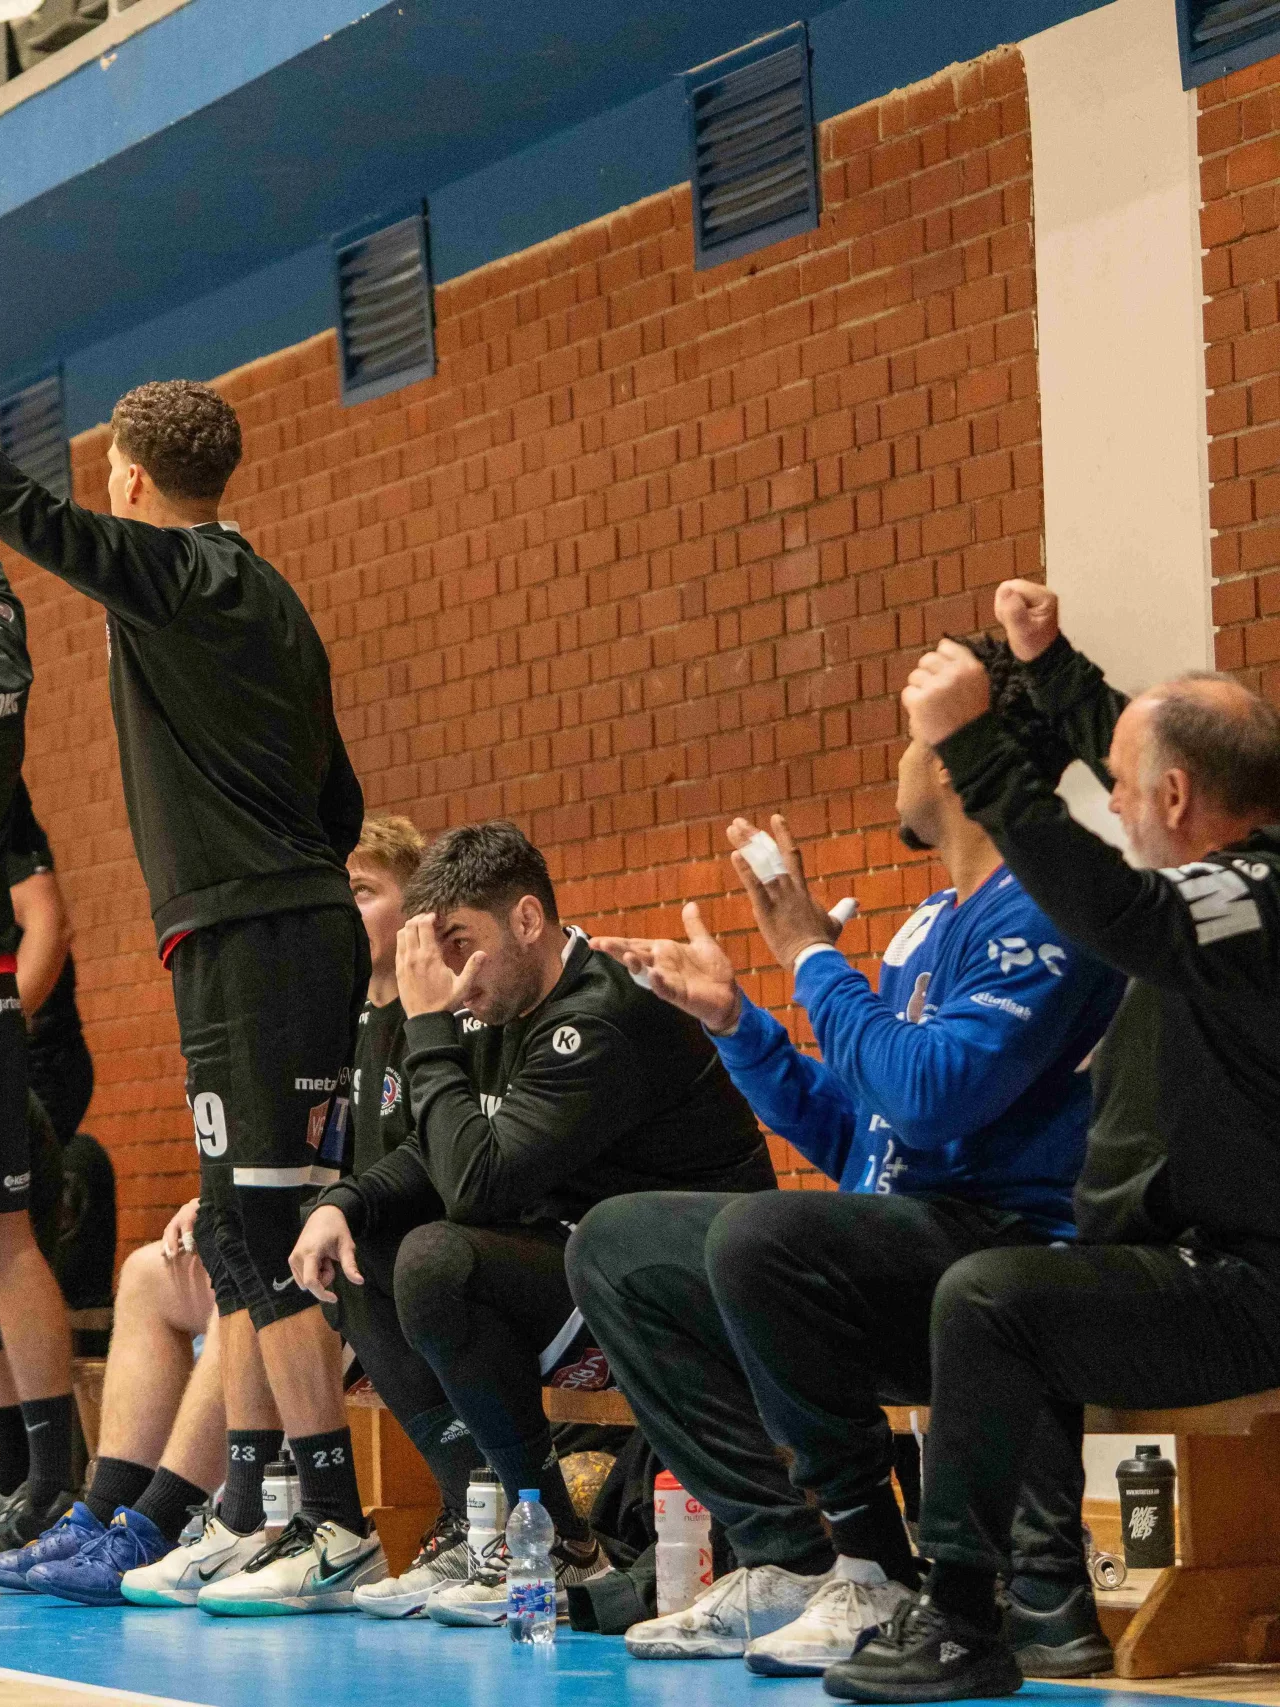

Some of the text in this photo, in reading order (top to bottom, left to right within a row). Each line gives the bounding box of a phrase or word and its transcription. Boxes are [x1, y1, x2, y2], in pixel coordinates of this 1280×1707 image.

[186, 1091, 228, 1157] 9
[440, 1428, 471, 1444] adida
[231, 1444, 256, 1462] 23
[312, 1447, 346, 1469] 23
[1131, 1505, 1158, 1517] ONE
[1128, 1515, 1159, 1528] MORE
[1131, 1526, 1153, 1540] REP
